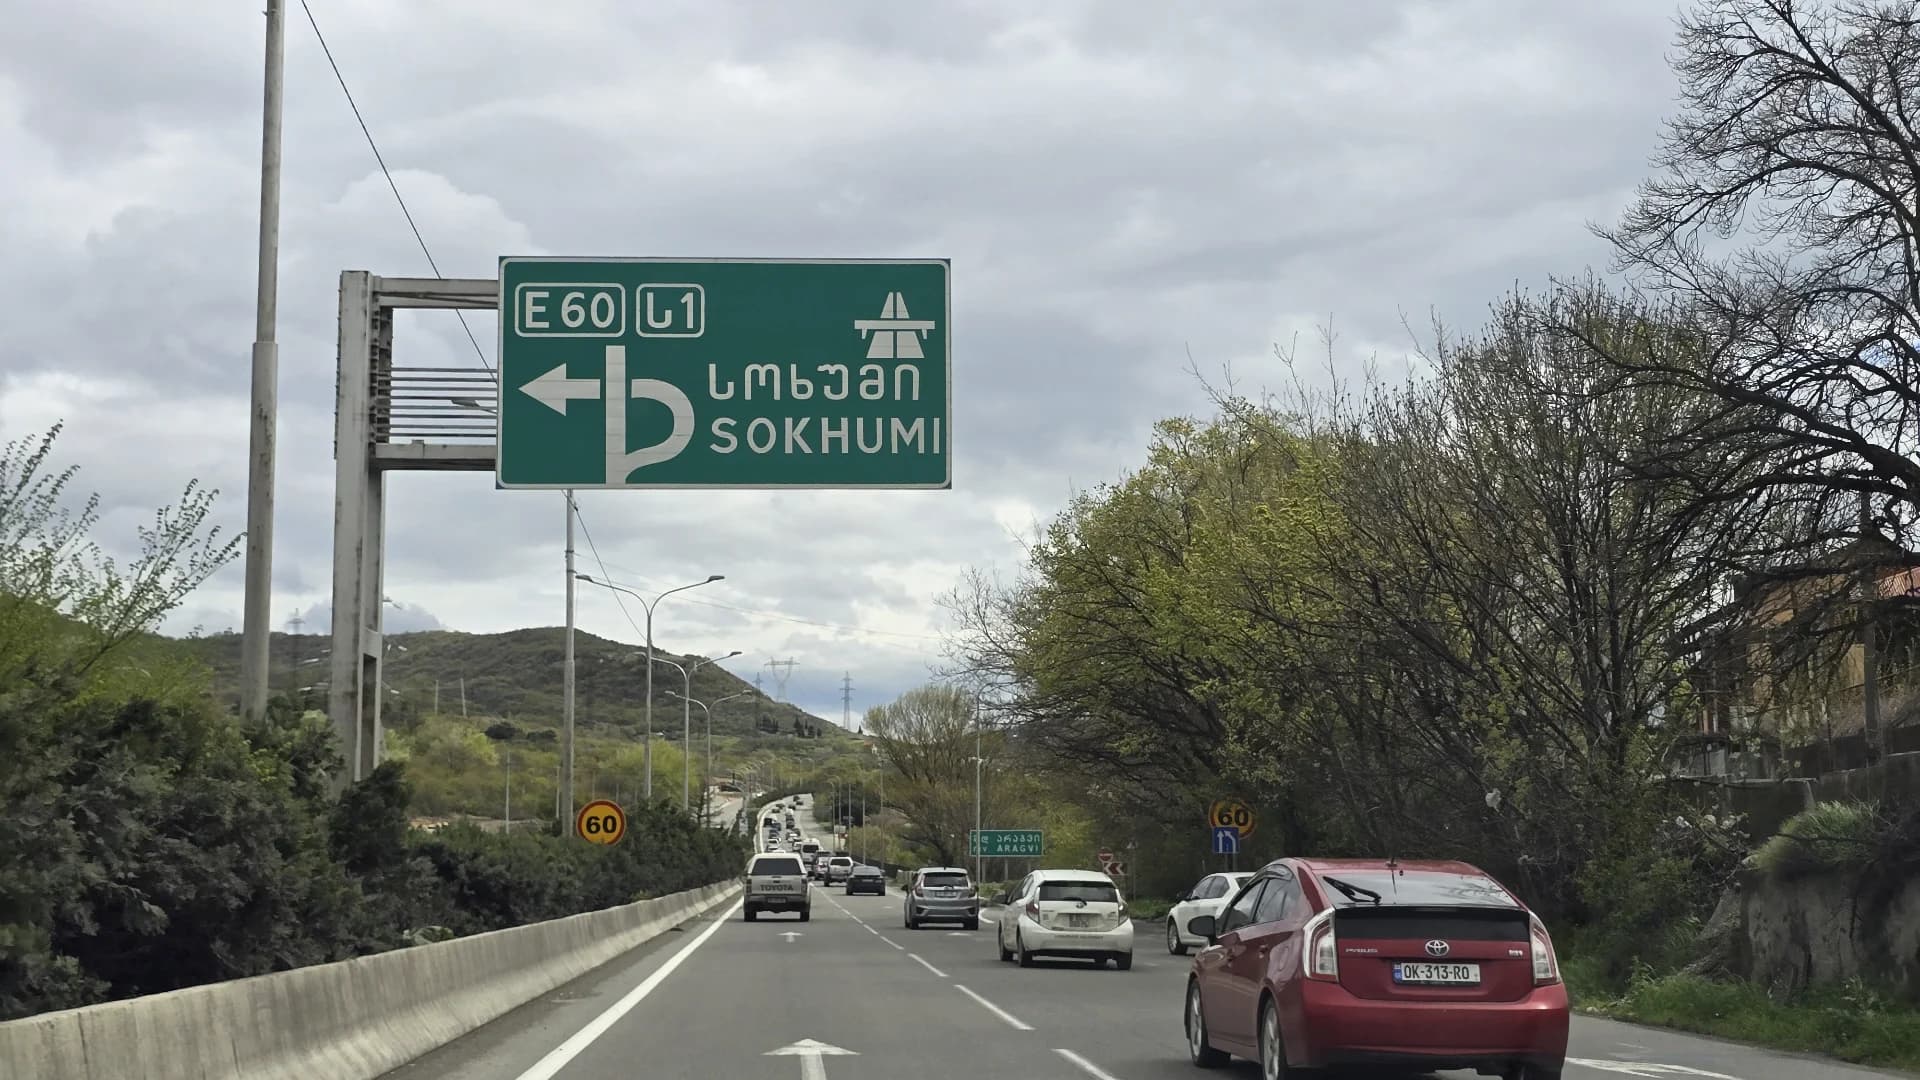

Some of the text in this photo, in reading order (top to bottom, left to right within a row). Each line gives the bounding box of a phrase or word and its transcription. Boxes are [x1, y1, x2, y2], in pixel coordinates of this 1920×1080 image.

[525, 291, 616, 328] E 60
[708, 363, 920, 401] სოხუმი
[709, 417, 941, 455] SOKHUMI
[586, 815, 617, 834] 60
[1218, 808, 1249, 827] 60
[996, 844, 1039, 853] ARAGVI
[1404, 964, 1470, 980] OK-313-RO
